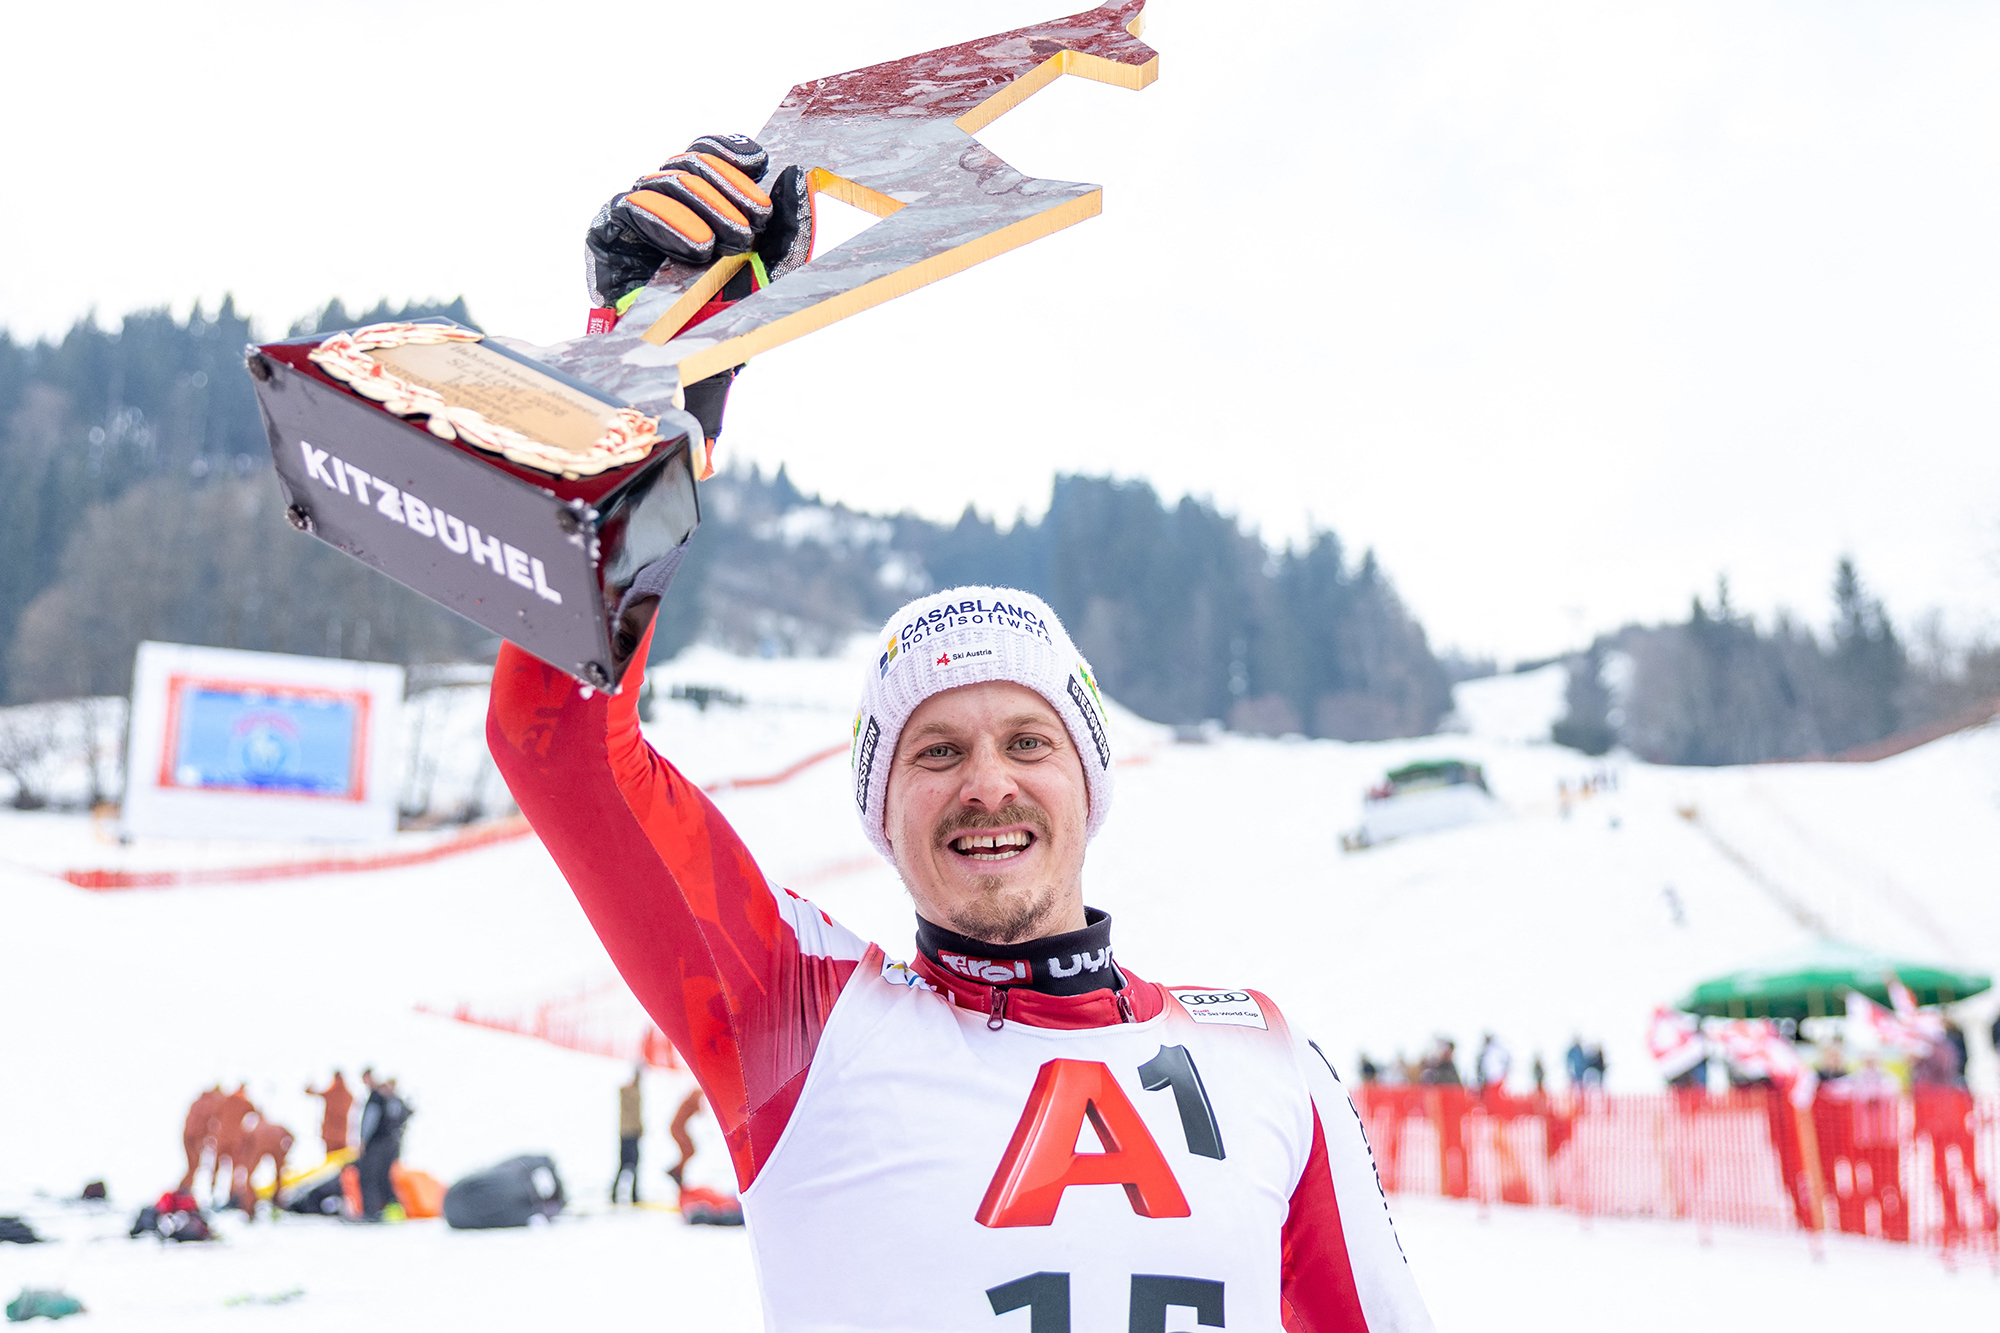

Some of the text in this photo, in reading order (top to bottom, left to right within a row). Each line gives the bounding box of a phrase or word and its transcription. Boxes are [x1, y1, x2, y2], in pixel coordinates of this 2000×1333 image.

[589, 317, 597, 335] ONE
[901, 599, 1049, 641] CASABLANCA
[902, 612, 1053, 654] hotelsoftware
[952, 648, 993, 661] Ski Austria
[1072, 682, 1110, 764] GIESSWEIN
